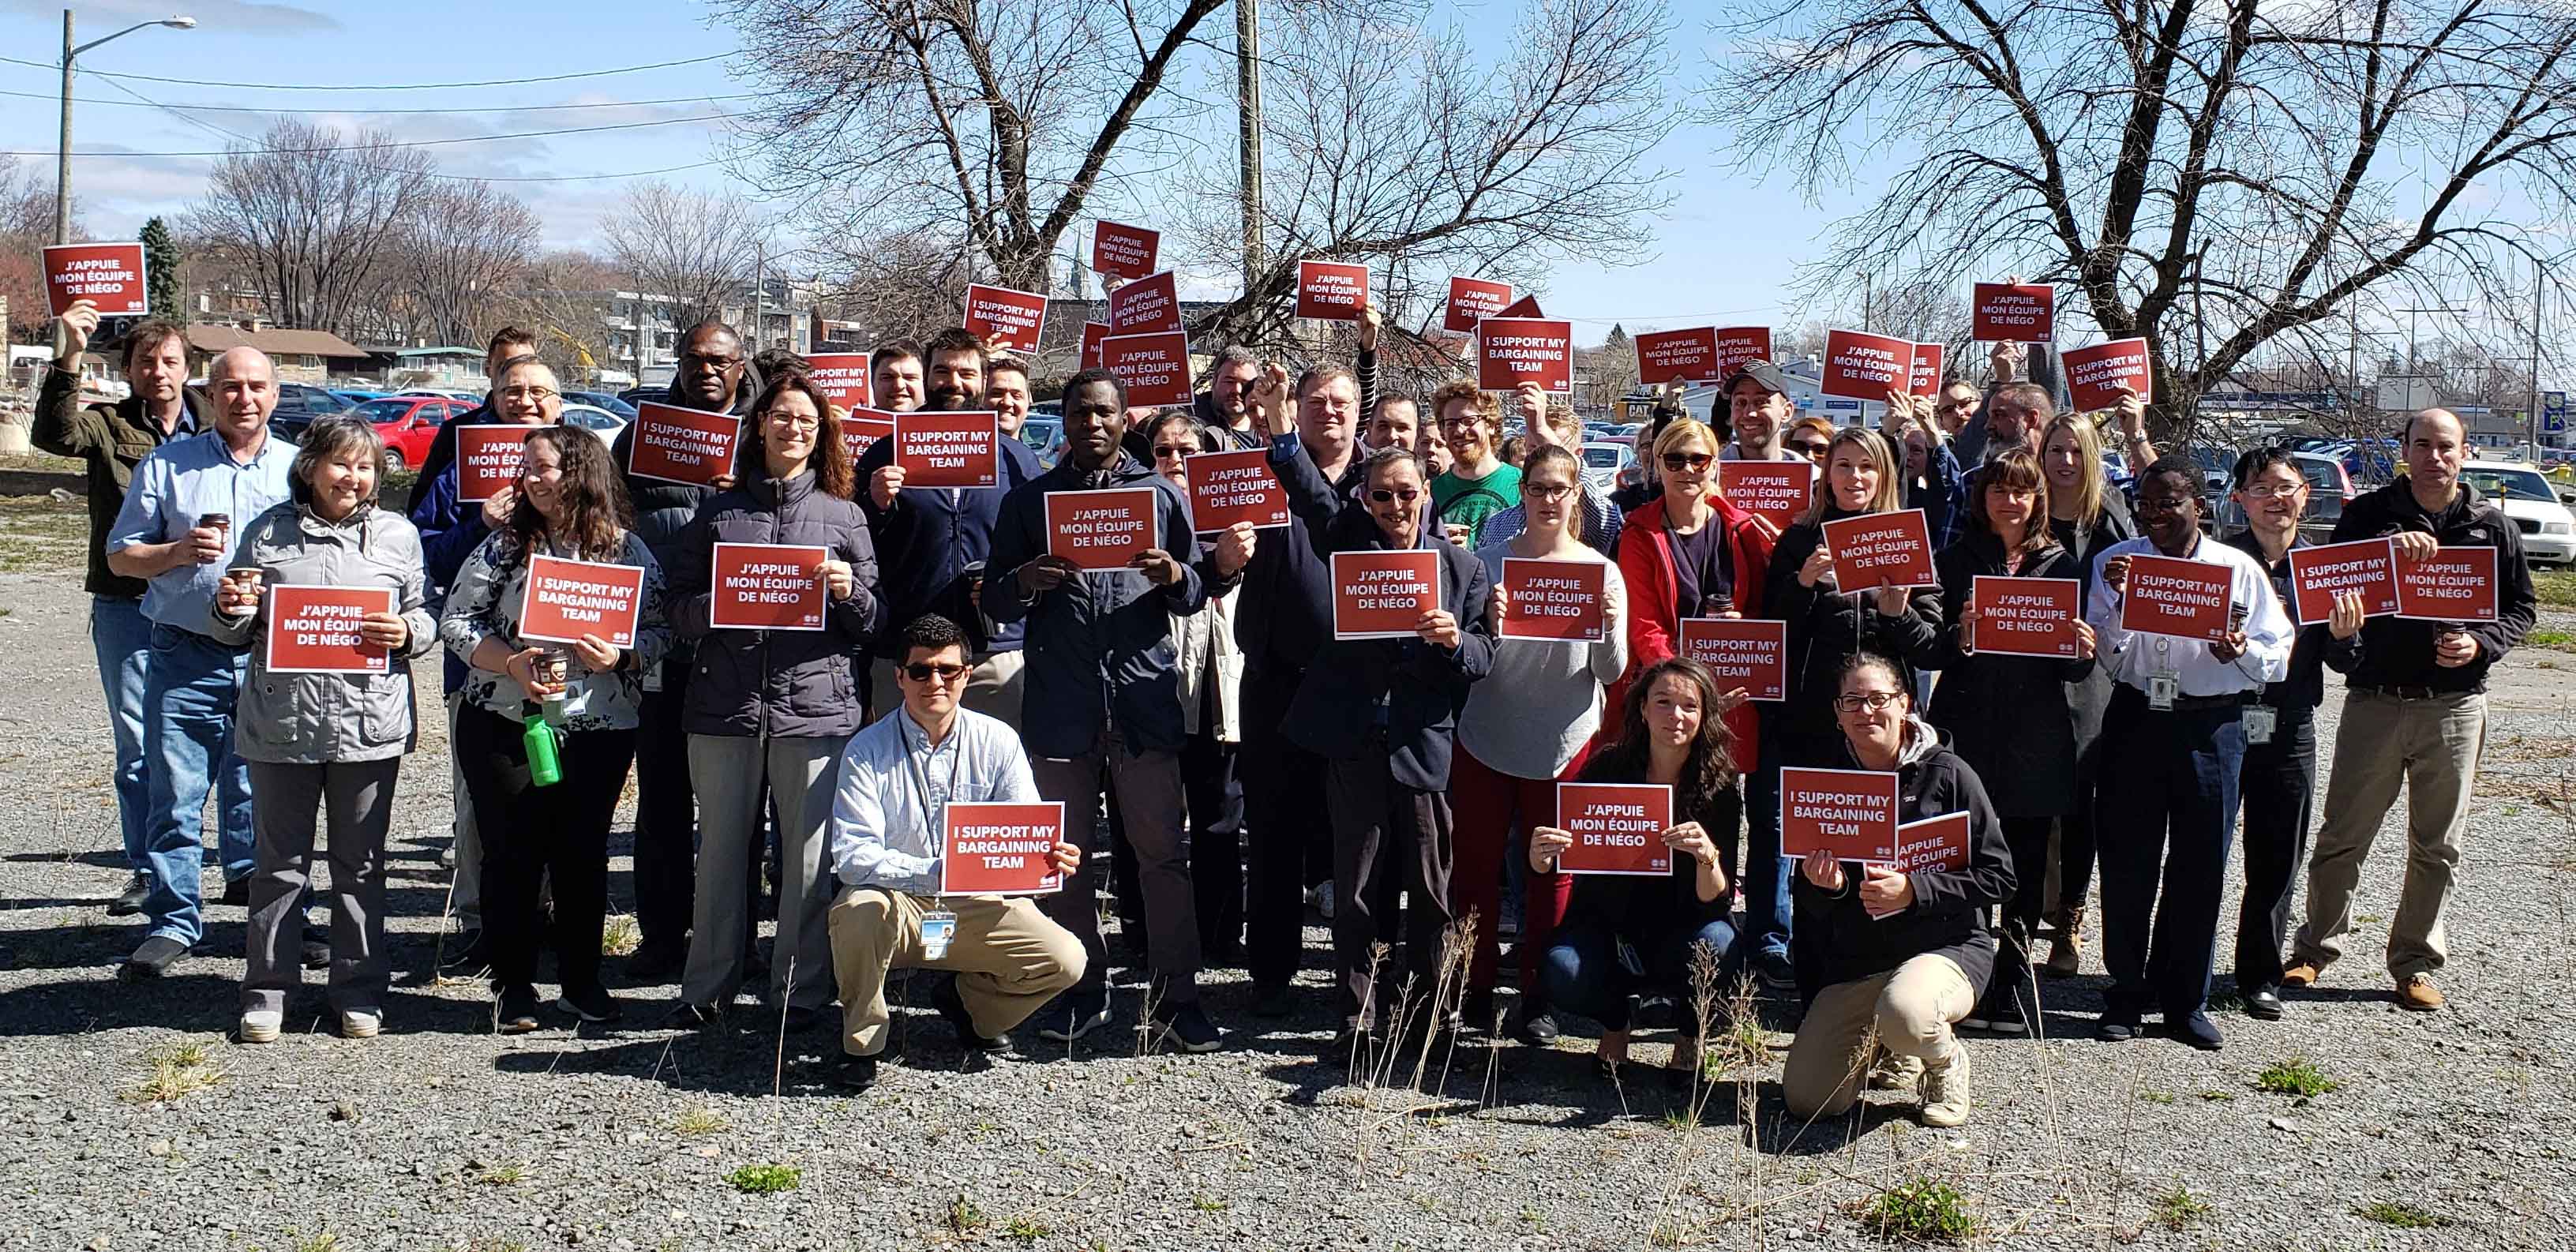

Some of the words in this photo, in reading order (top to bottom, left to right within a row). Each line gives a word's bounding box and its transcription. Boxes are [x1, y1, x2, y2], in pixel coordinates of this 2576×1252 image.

[1107, 234, 1142, 247] J'APPUIE
[1099, 241, 1117, 252] MON
[1118, 244, 1149, 257] ÉQUIPE
[1104, 251, 1114, 261] DE
[1115, 254, 1139, 264] NÉGO
[65, 259, 120, 270] J'APPUIE
[55, 272, 84, 283] MON
[87, 270, 134, 281] ÉQUIPE
[1315, 275, 1354, 285] J'APPUIE
[66, 284, 82, 294] DE
[84, 281, 123, 293] NÉGO
[1306, 283, 1329, 293] MON
[1330, 284, 1362, 295] ÉQUIPE
[1122, 288, 1158, 306] J'APPUIE
[1327, 294, 1354, 304] NÉGO
[1464, 290, 1499, 302] J'APPUIE
[978, 301, 1024, 315] SUPPORT
[1025, 309, 1041, 317] MY
[1115, 306, 1134, 319] MON
[1136, 296, 1168, 312] ÉQUIPE
[1454, 298, 1476, 308] MON
[2008, 304, 2044, 314] ÉQUIPE
[974, 311, 1035, 327] BARGAINING
[1122, 316, 1134, 326] DE
[1135, 309, 1162, 322] NÉGO
[2006, 314, 2034, 324] NÉGO
[991, 323, 1018, 335] TEAM
[1492, 336, 1546, 347] SUPPORT
[1547, 338, 1566, 347] MY
[1655, 338, 1697, 349] J'APPUIE
[1119, 350, 1165, 362] J'APPUIE
[1489, 349, 1562, 360] BARGAINING
[1672, 346, 1708, 355] ÉQUIPE
[1846, 346, 1894, 361] J'APPUIE
[1671, 355, 1700, 365] NÉGO
[1834, 356, 1862, 366] MON
[1865, 359, 1903, 374] ÉQUIPE
[2076, 355, 2126, 373] SUPPORT
[2128, 354, 2143, 363] MY
[1138, 362, 1179, 373] ÉQUIPE
[1509, 361, 1542, 372] TEAM
[1136, 373, 1169, 385] NÉGO
[1843, 369, 1858, 377] DE
[1860, 370, 1892, 382] NÉGO
[2076, 366, 2143, 384] BARGAINING
[1629, 404, 1648, 417] CAT
[643, 422, 647, 430] I
[651, 422, 709, 440] SUPPORT
[710, 434, 732, 445] MY
[902, 432, 906, 442] I
[909, 431, 968, 442] SUPPORT
[970, 431, 991, 441] MY
[645, 434, 725, 456] BARGAINING
[906, 444, 987, 455] BARGAINING
[468, 455, 499, 465] MON
[666, 450, 700, 465] TEAM
[928, 457, 964, 467] TEAM
[479, 467, 496, 478] DE
[1209, 467, 1262, 481] J'APPUIE
[1198, 483, 1227, 495] MON
[1231, 478, 1276, 492] ÉQUIPE
[1738, 476, 1789, 485] J'APPUIE
[1727, 488, 1755, 497] MON
[1758, 486, 1800, 497] ÉQUIPE
[1211, 497, 1226, 507] DE
[1229, 493, 1265, 505] NÉGO
[1737, 500, 1752, 508] DE
[1755, 497, 1788, 509] NÉGO
[1072, 508, 1129, 520] J'APPUIE
[1059, 523, 1092, 534] MON
[1096, 520, 1143, 532] ÉQUIPE
[1073, 536, 1090, 546] DE
[1093, 533, 1131, 545] NÉGO
[1850, 528, 1904, 544] J'APPUIE
[1840, 545, 1872, 558] MON
[1874, 539, 1919, 553] ÉQUIPE
[1855, 557, 1873, 568] DE
[1874, 553, 1910, 565] NÉGO
[740, 563, 799, 575] J'APPUIE
[2300, 568, 2304, 577] I
[2307, 560, 2364, 576] SUPPORT
[2367, 557, 2386, 568] MY
[2417, 563, 2471, 573] J'APPUIE
[1358, 569, 1415, 581] J'APPUIE
[2305, 571, 2384, 590] BARGAINING
[2405, 574, 2435, 585] MON
[2438, 574, 2484, 586] ÉQUIPE
[536, 576, 542, 587] I
[542, 577, 609, 595] SUPPORT
[610, 585, 634, 598] MY
[726, 576, 759, 588] MON
[763, 575, 812, 589] ÉQUIPE
[1345, 584, 1378, 594] MON
[1381, 582, 1428, 594] ÉQUIPE
[1526, 578, 1580, 589] J'APPUIE
[2134, 574, 2138, 583] I
[2141, 575, 2203, 590] SUPPORT
[2205, 584, 2226, 595] MY
[738, 591, 756, 602] DE
[759, 590, 799, 602] NÉGO
[1513, 590, 1543, 601] MON
[1547, 589, 1593, 603] ÉQUIPE
[2136, 587, 2220, 606] BARGAINING
[2417, 587, 2433, 597] DE
[2435, 587, 2472, 598] NÉGO
[538, 590, 627, 611] BARGAINING
[1358, 598, 1375, 609] DE
[1378, 595, 1416, 608] NÉGO
[1997, 594, 2053, 606] J'APPUIE
[299, 605, 363, 617] J'APPUIE
[561, 606, 601, 622] TEAM
[1524, 604, 1541, 614] DE
[1544, 603, 1580, 617] NÉGO
[1985, 606, 2016, 617] MON
[2019, 606, 2066, 620] ÉQUIPE
[2158, 603, 2195, 617] TEAM
[283, 619, 321, 631] MON
[1997, 620, 2013, 630] DE
[2016, 619, 2053, 632] NÉGO
[297, 633, 317, 645] DE
[320, 632, 362, 646] NÉGO
[1689, 639, 1692, 649] I
[1695, 639, 1755, 650] SUPPORT
[1757, 640, 1778, 650] MY
[1692, 652, 1773, 664] BARGAINING
[1715, 665, 1749, 677] TEAM
[1790, 790, 1794, 801] I
[1798, 791, 1864, 805] SUPPORT
[1866, 795, 1890, 807] MY
[1584, 804, 1644, 816] J'APPUIE
[1794, 806, 1884, 822] BARGAINING
[1570, 819, 1604, 830] MON
[1608, 817, 1658, 831] ÉQUIPE
[1817, 823, 1858, 835] TEAM
[954, 826, 958, 838] I
[962, 826, 1029, 838] SUPPORT
[1033, 826, 1056, 838] MY
[1584, 834, 1602, 845] DE
[1605, 832, 1645, 846] NÉGO
[958, 841, 1050, 853] BARGAINING
[982, 856, 1023, 868] TEAM
